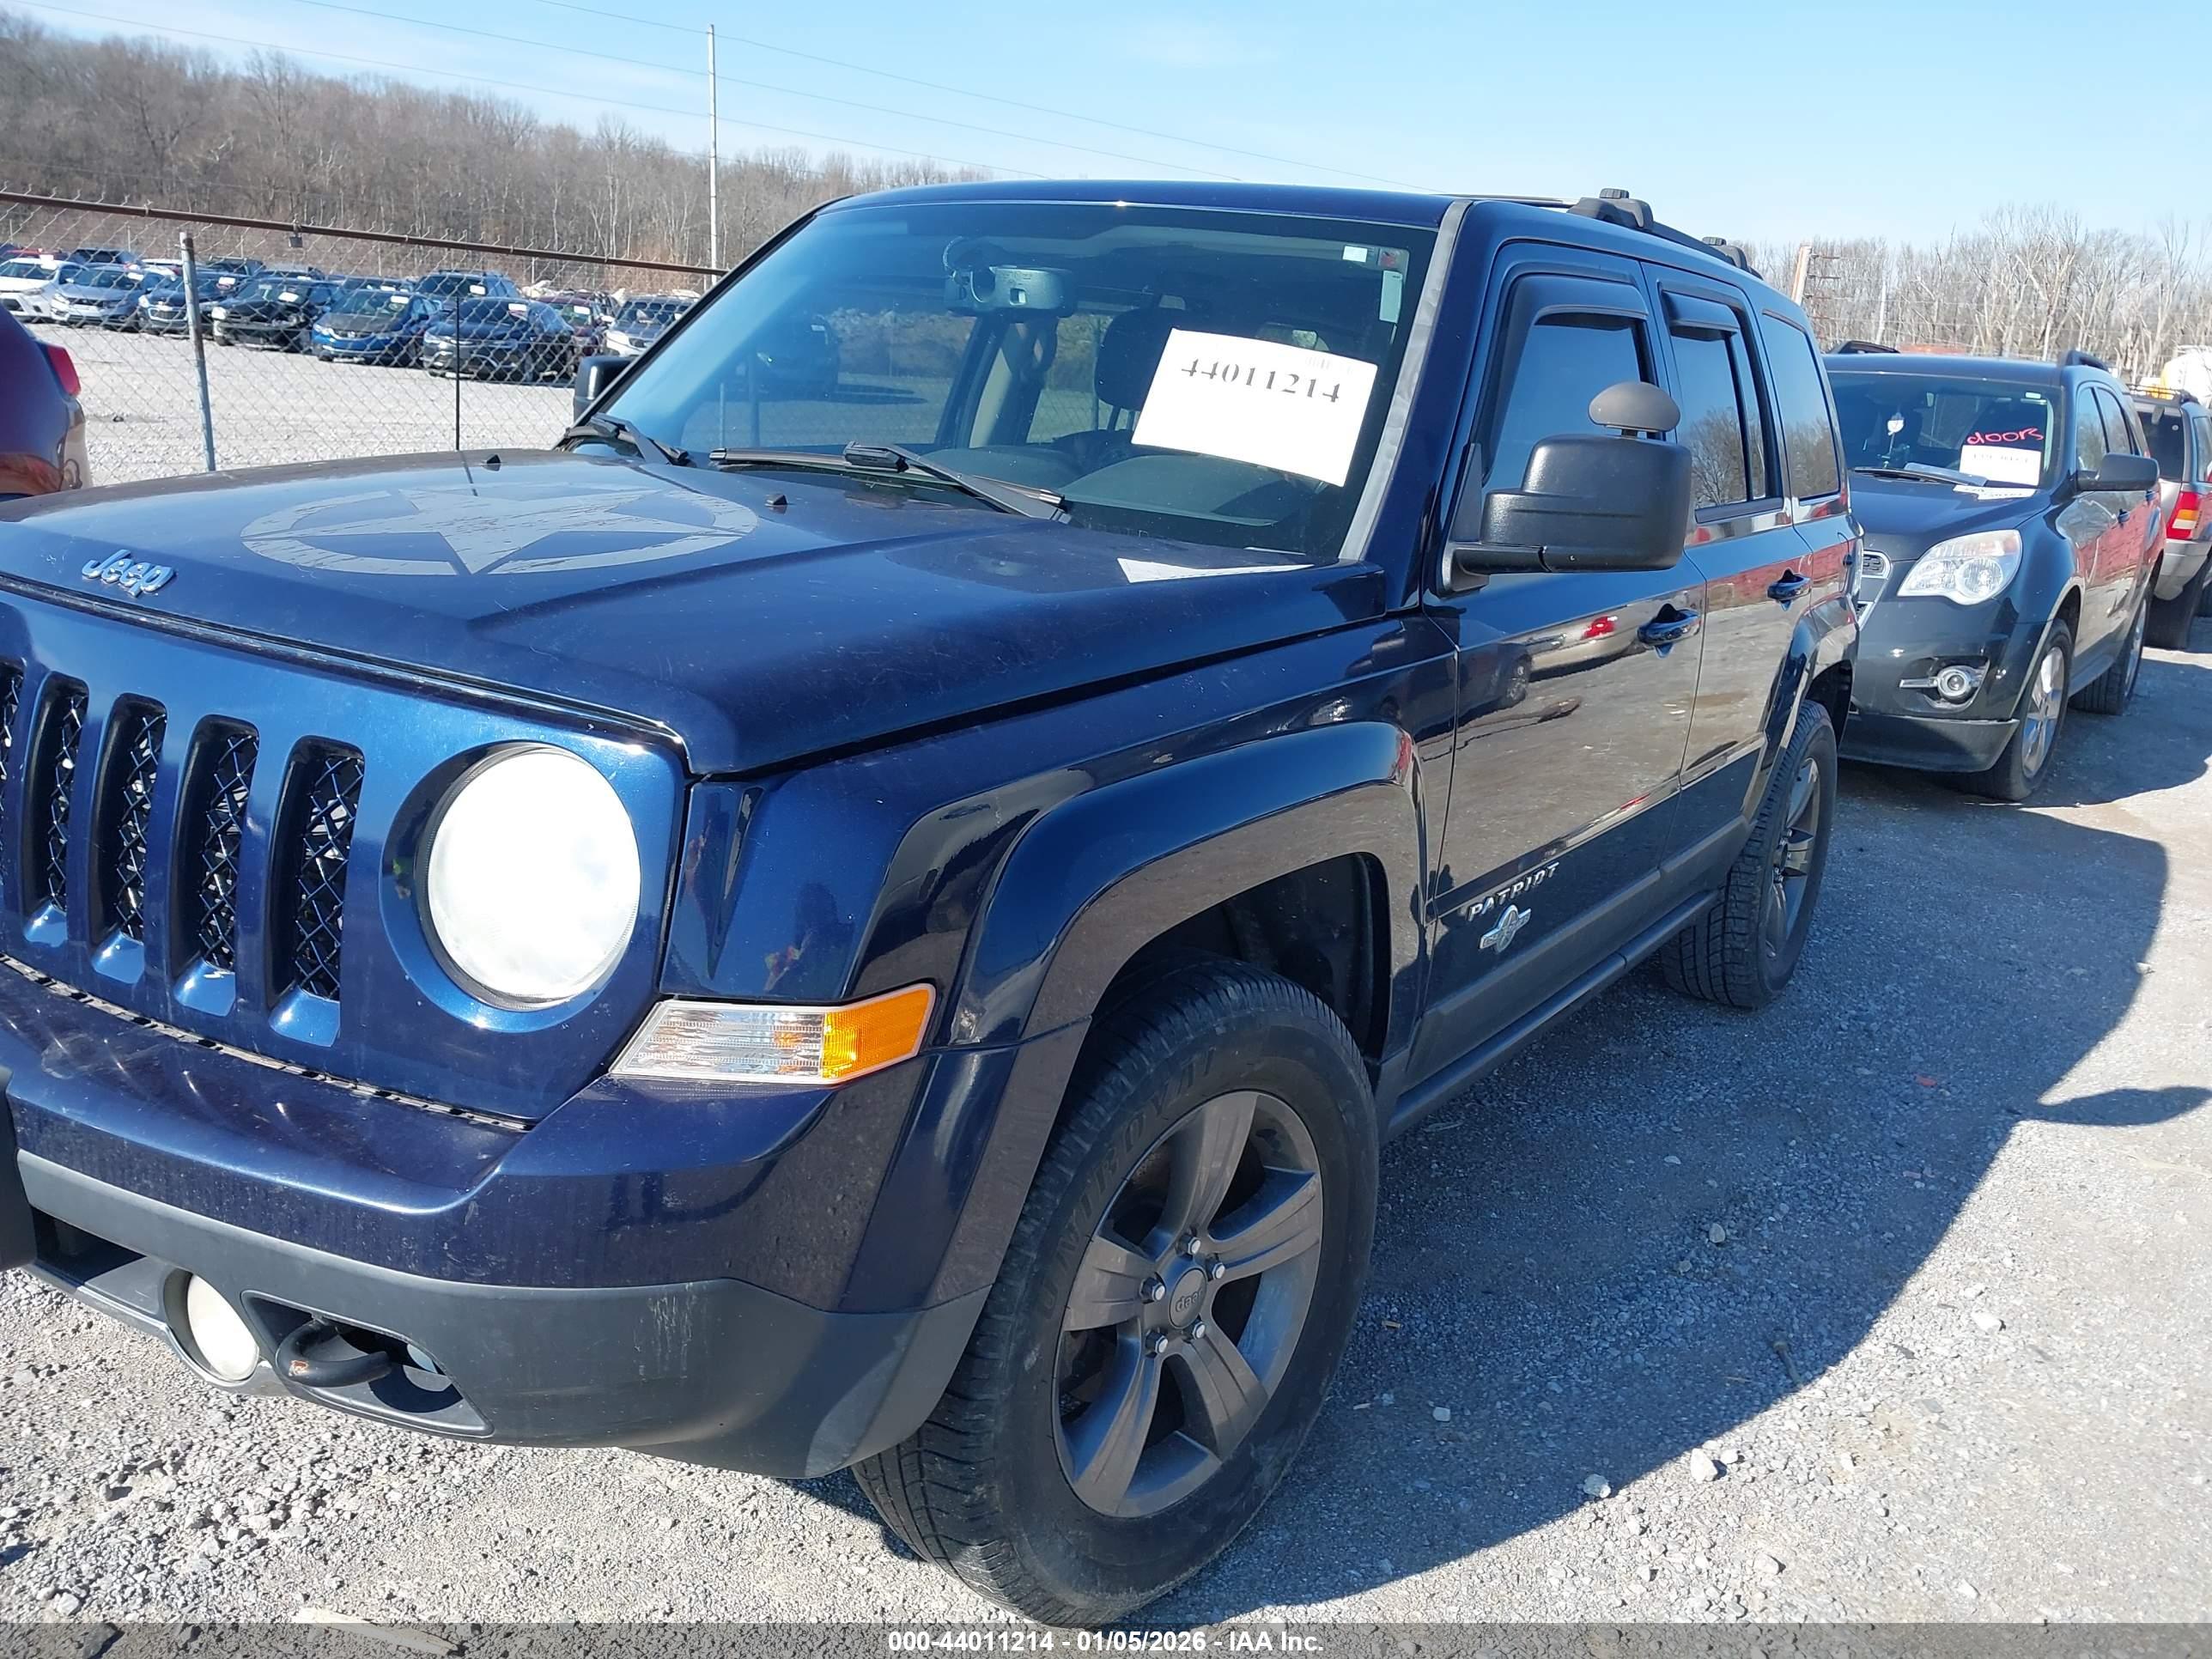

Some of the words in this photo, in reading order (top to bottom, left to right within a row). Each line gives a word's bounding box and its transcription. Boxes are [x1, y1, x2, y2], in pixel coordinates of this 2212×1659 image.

[1181, 357, 1340, 403] 44011214
[82, 549, 174, 598] Jeep
[1467, 861, 1559, 921] PATRIOT
